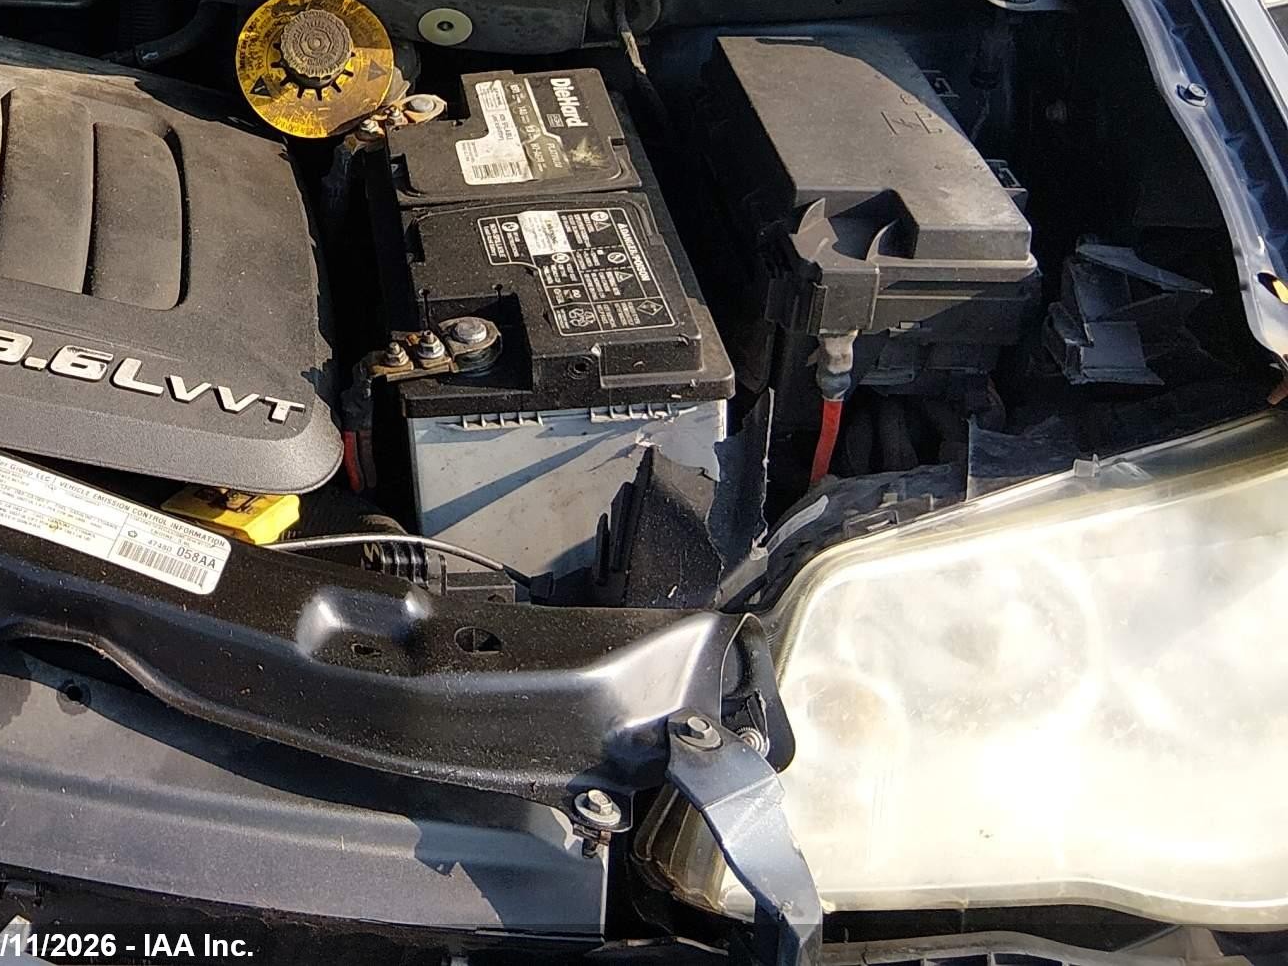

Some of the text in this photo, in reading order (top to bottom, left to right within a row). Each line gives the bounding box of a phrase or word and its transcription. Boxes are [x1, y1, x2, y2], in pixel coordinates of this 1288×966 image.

[550, 78, 589, 128] DieHard
[9, 463, 34, 478] Group
[59, 482, 89, 496] VEHICLE
[92, 494, 130, 512] EMISSION
[132, 508, 167, 526] CONTROL
[170, 522, 225, 547] INFORMATION
[176, 547, 217, 569] 058AA
